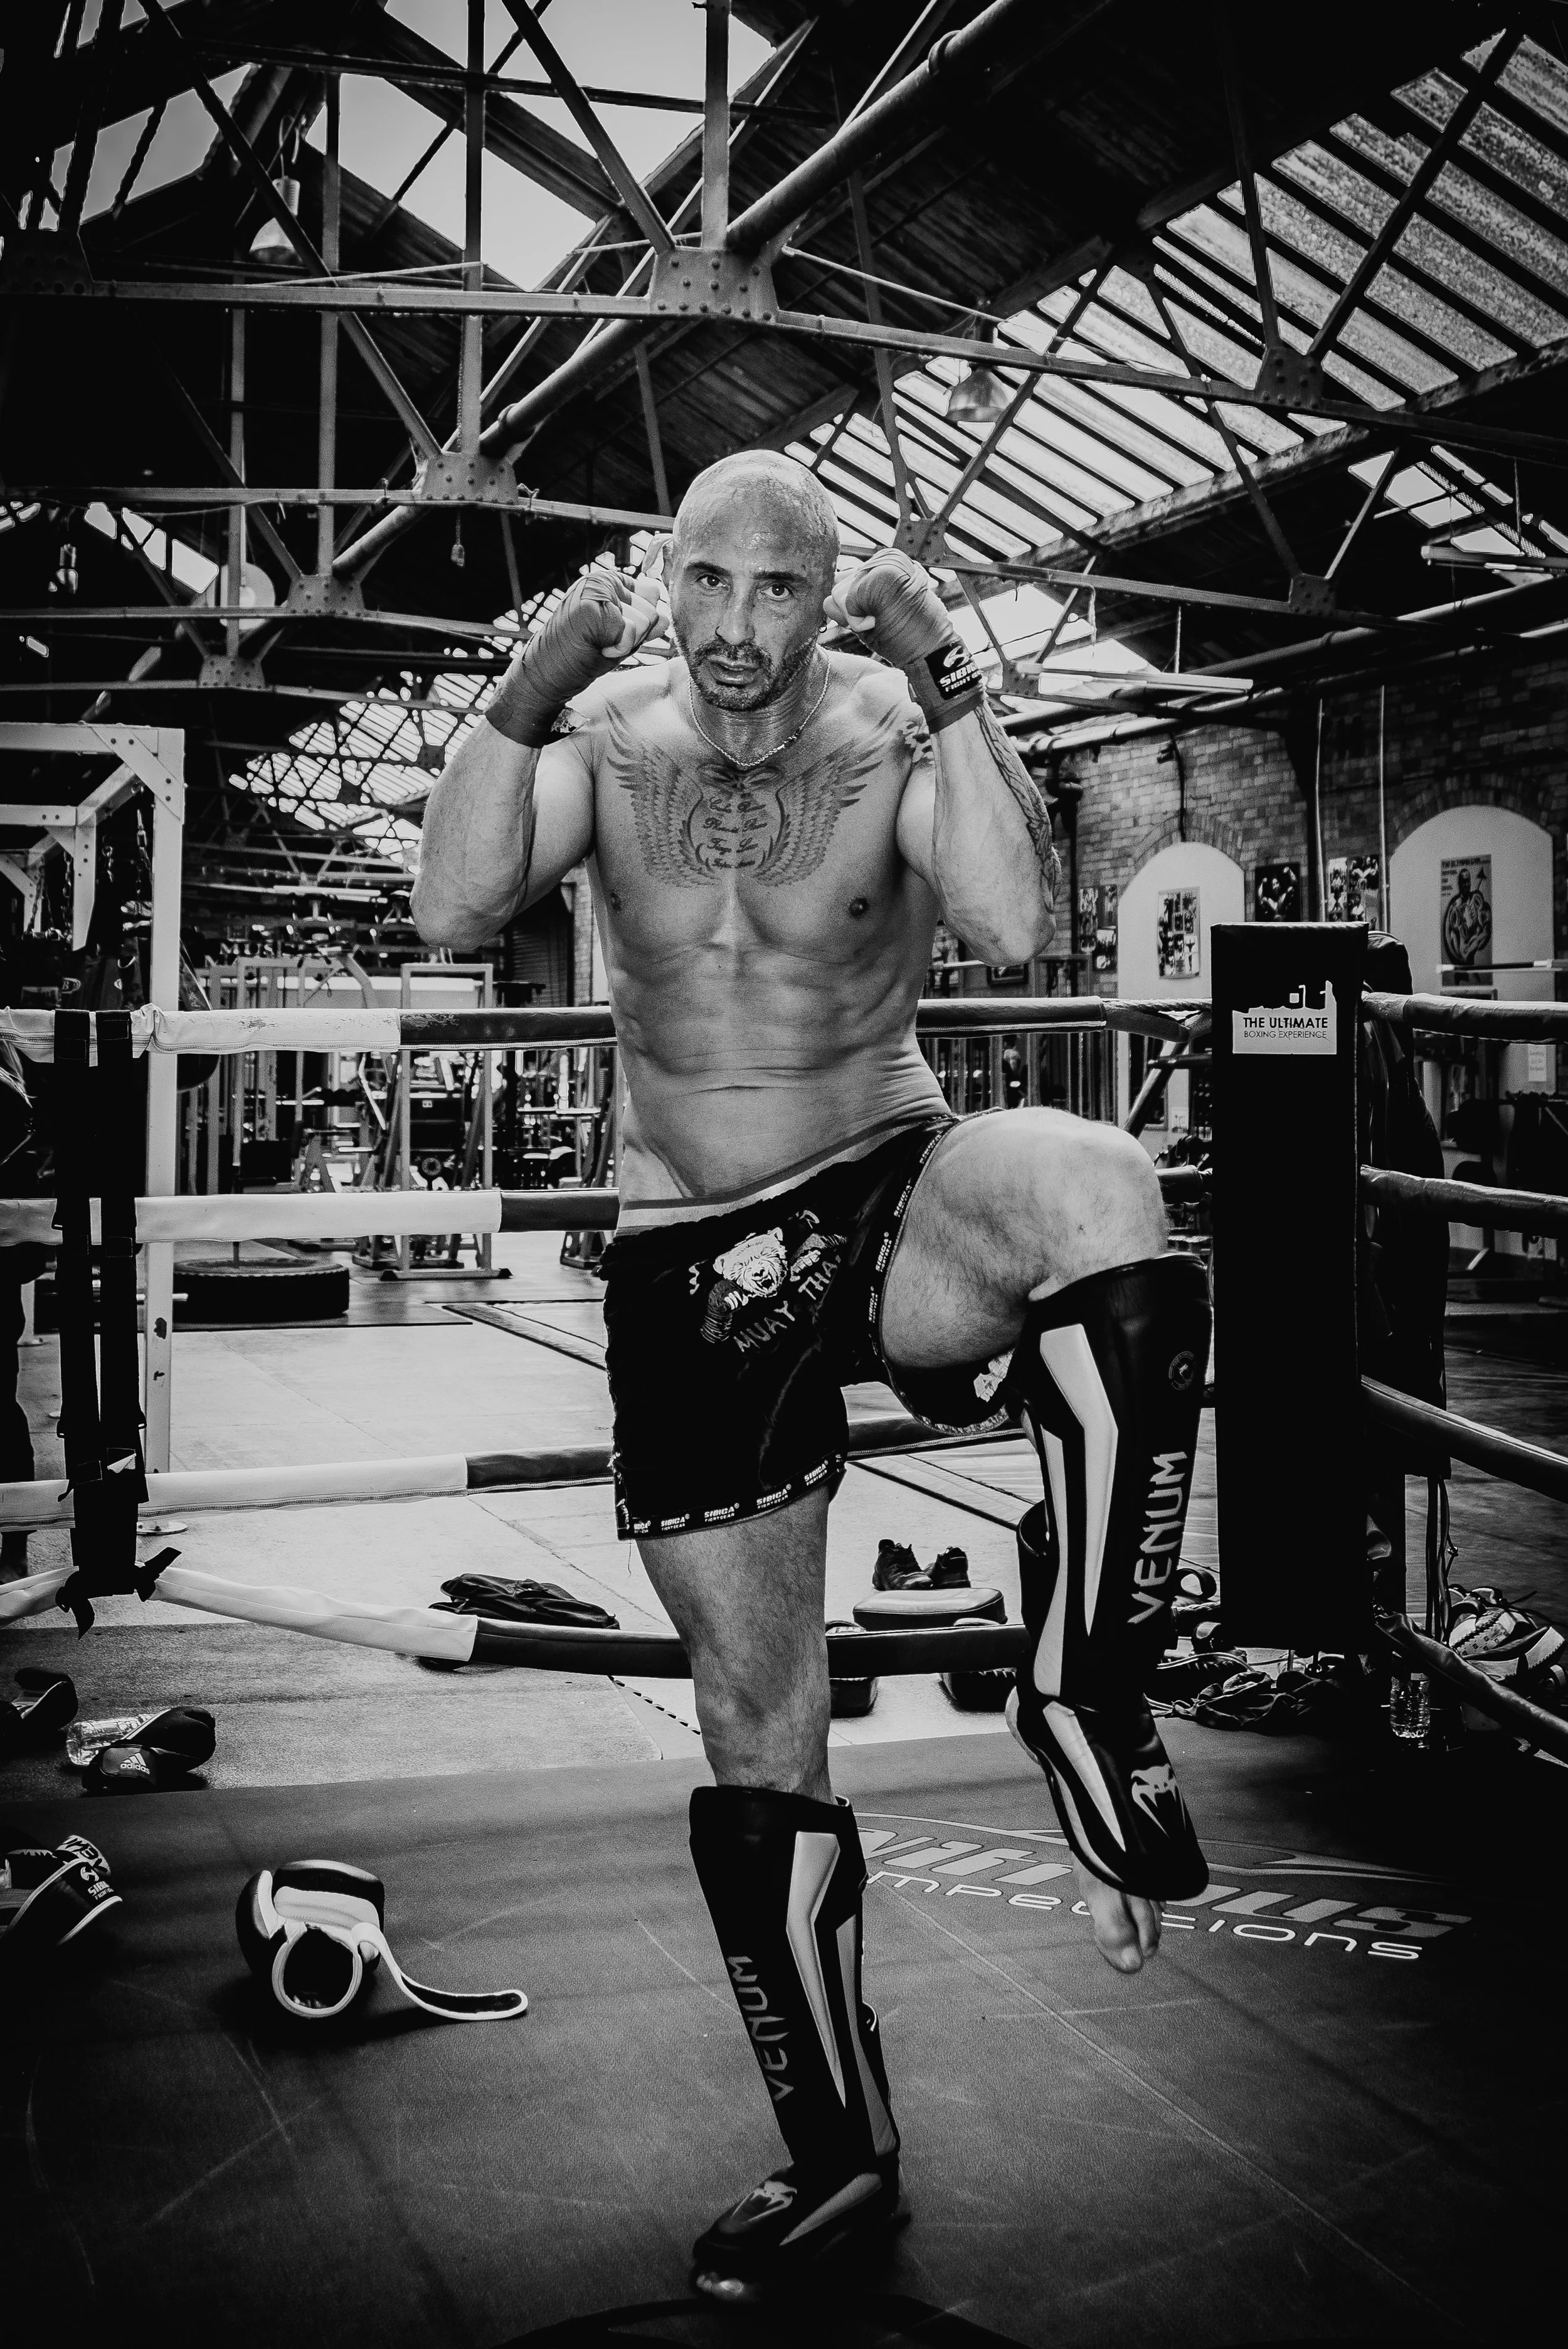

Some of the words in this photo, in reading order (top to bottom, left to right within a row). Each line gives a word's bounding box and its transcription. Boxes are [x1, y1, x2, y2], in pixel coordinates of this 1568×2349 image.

[1243, 1017, 1265, 1028] THE
[1269, 1017, 1328, 1028] ULTIMATE
[733, 1300, 795, 1352] MUAY
[1127, 1451, 1188, 1625] VENUM
[120, 1761, 151, 1774] adidas
[726, 1956, 795, 2102] VENUM
